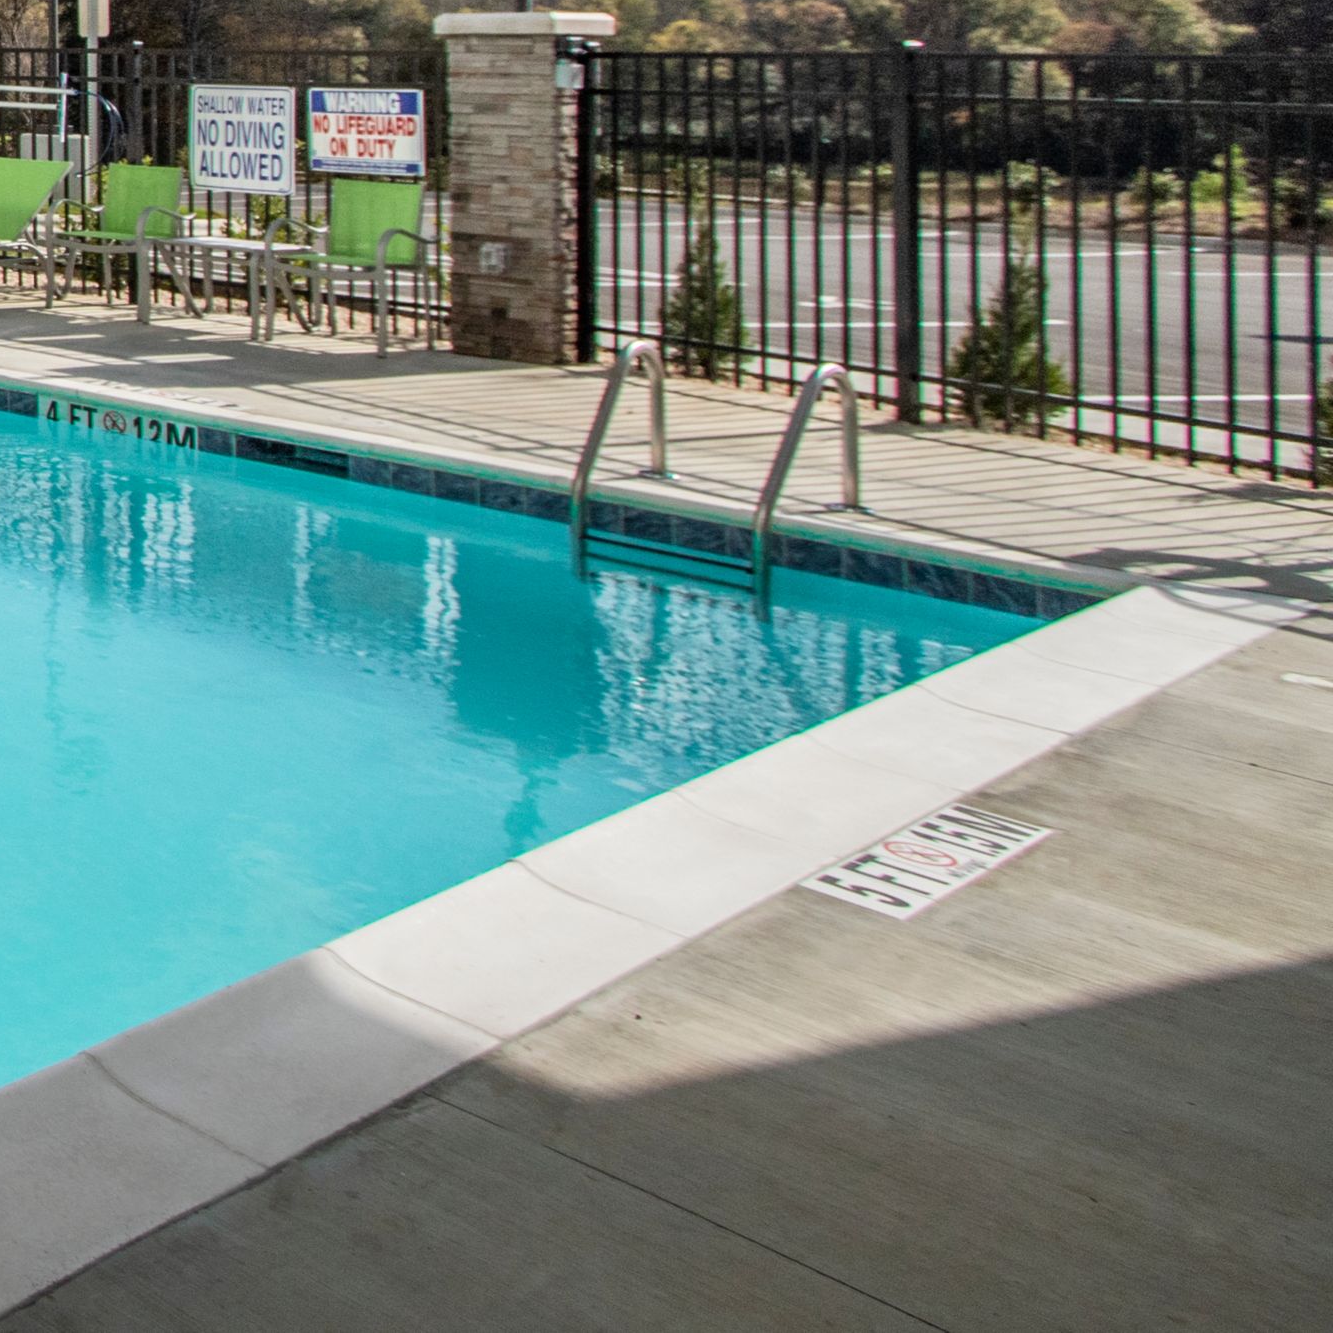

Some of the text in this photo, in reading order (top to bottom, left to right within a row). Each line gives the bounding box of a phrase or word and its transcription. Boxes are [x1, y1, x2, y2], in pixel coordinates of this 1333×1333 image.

[197, 95, 286, 116] SHALLOW WATER
[324, 91, 401, 114] WARNING
[197, 119, 285, 150] NO DIVING
[313, 115, 417, 136] NO LIFEGUARD
[330, 137, 397, 158] ON DUTY
[199, 150, 283, 181] ALLOWED
[47, 400, 58, 421] 4
[69, 403, 98, 428] FT
[840, 854, 951, 896] FT
[817, 874, 911, 908] 5
